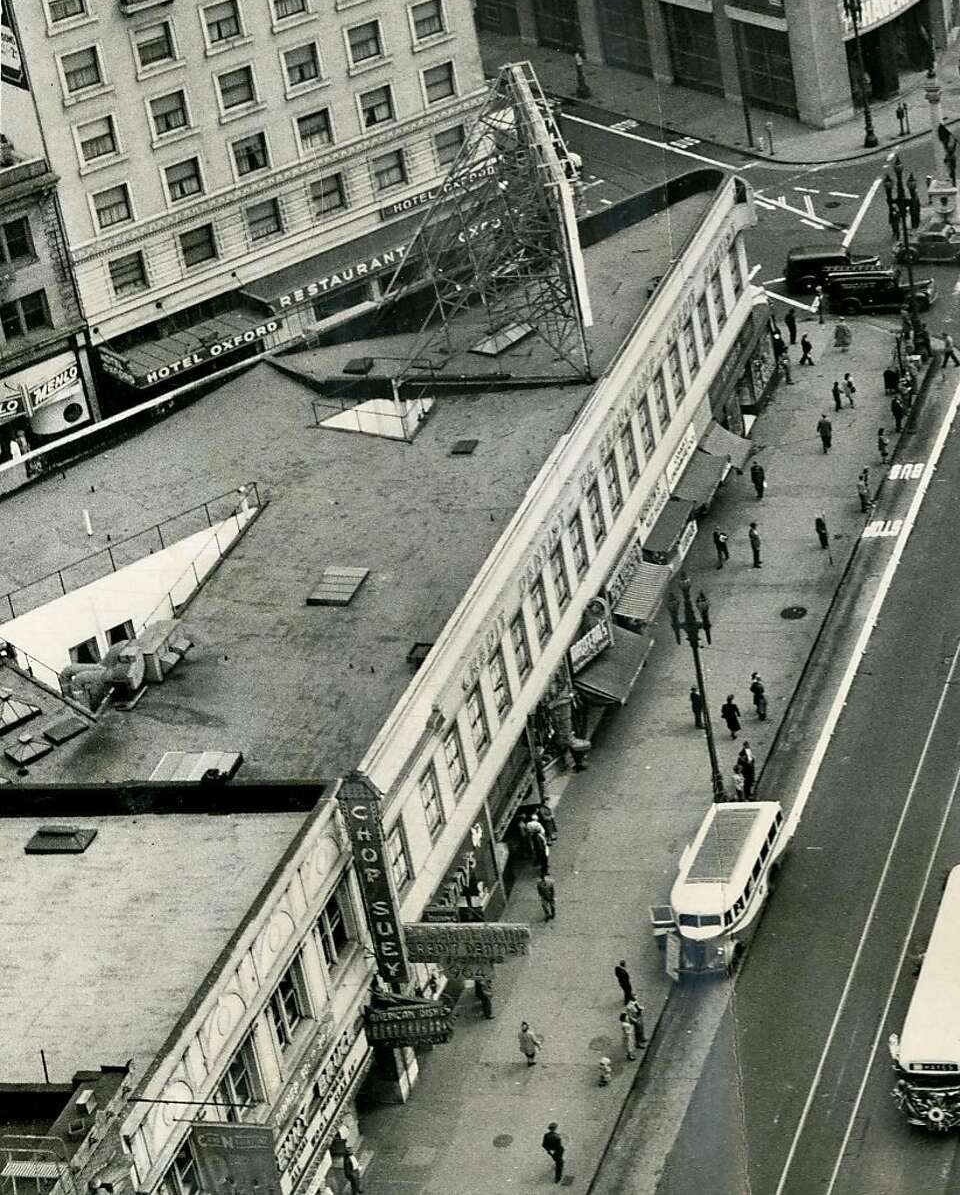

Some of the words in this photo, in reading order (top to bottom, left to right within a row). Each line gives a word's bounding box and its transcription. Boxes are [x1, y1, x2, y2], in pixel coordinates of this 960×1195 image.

[393, 190, 436, 214] HOTEL
[278, 246, 407, 308] RESTAURANT
[146, 350, 206, 385] HOTEL
[208, 319, 281, 359] OXFORD
[33, 366, 78, 405] MENLO
[350, 805, 380, 883] CHOP
[372, 900, 401, 978] SUEY
[408, 943, 458, 957] CREDIT
[465, 942, 526, 956] DENTIST
